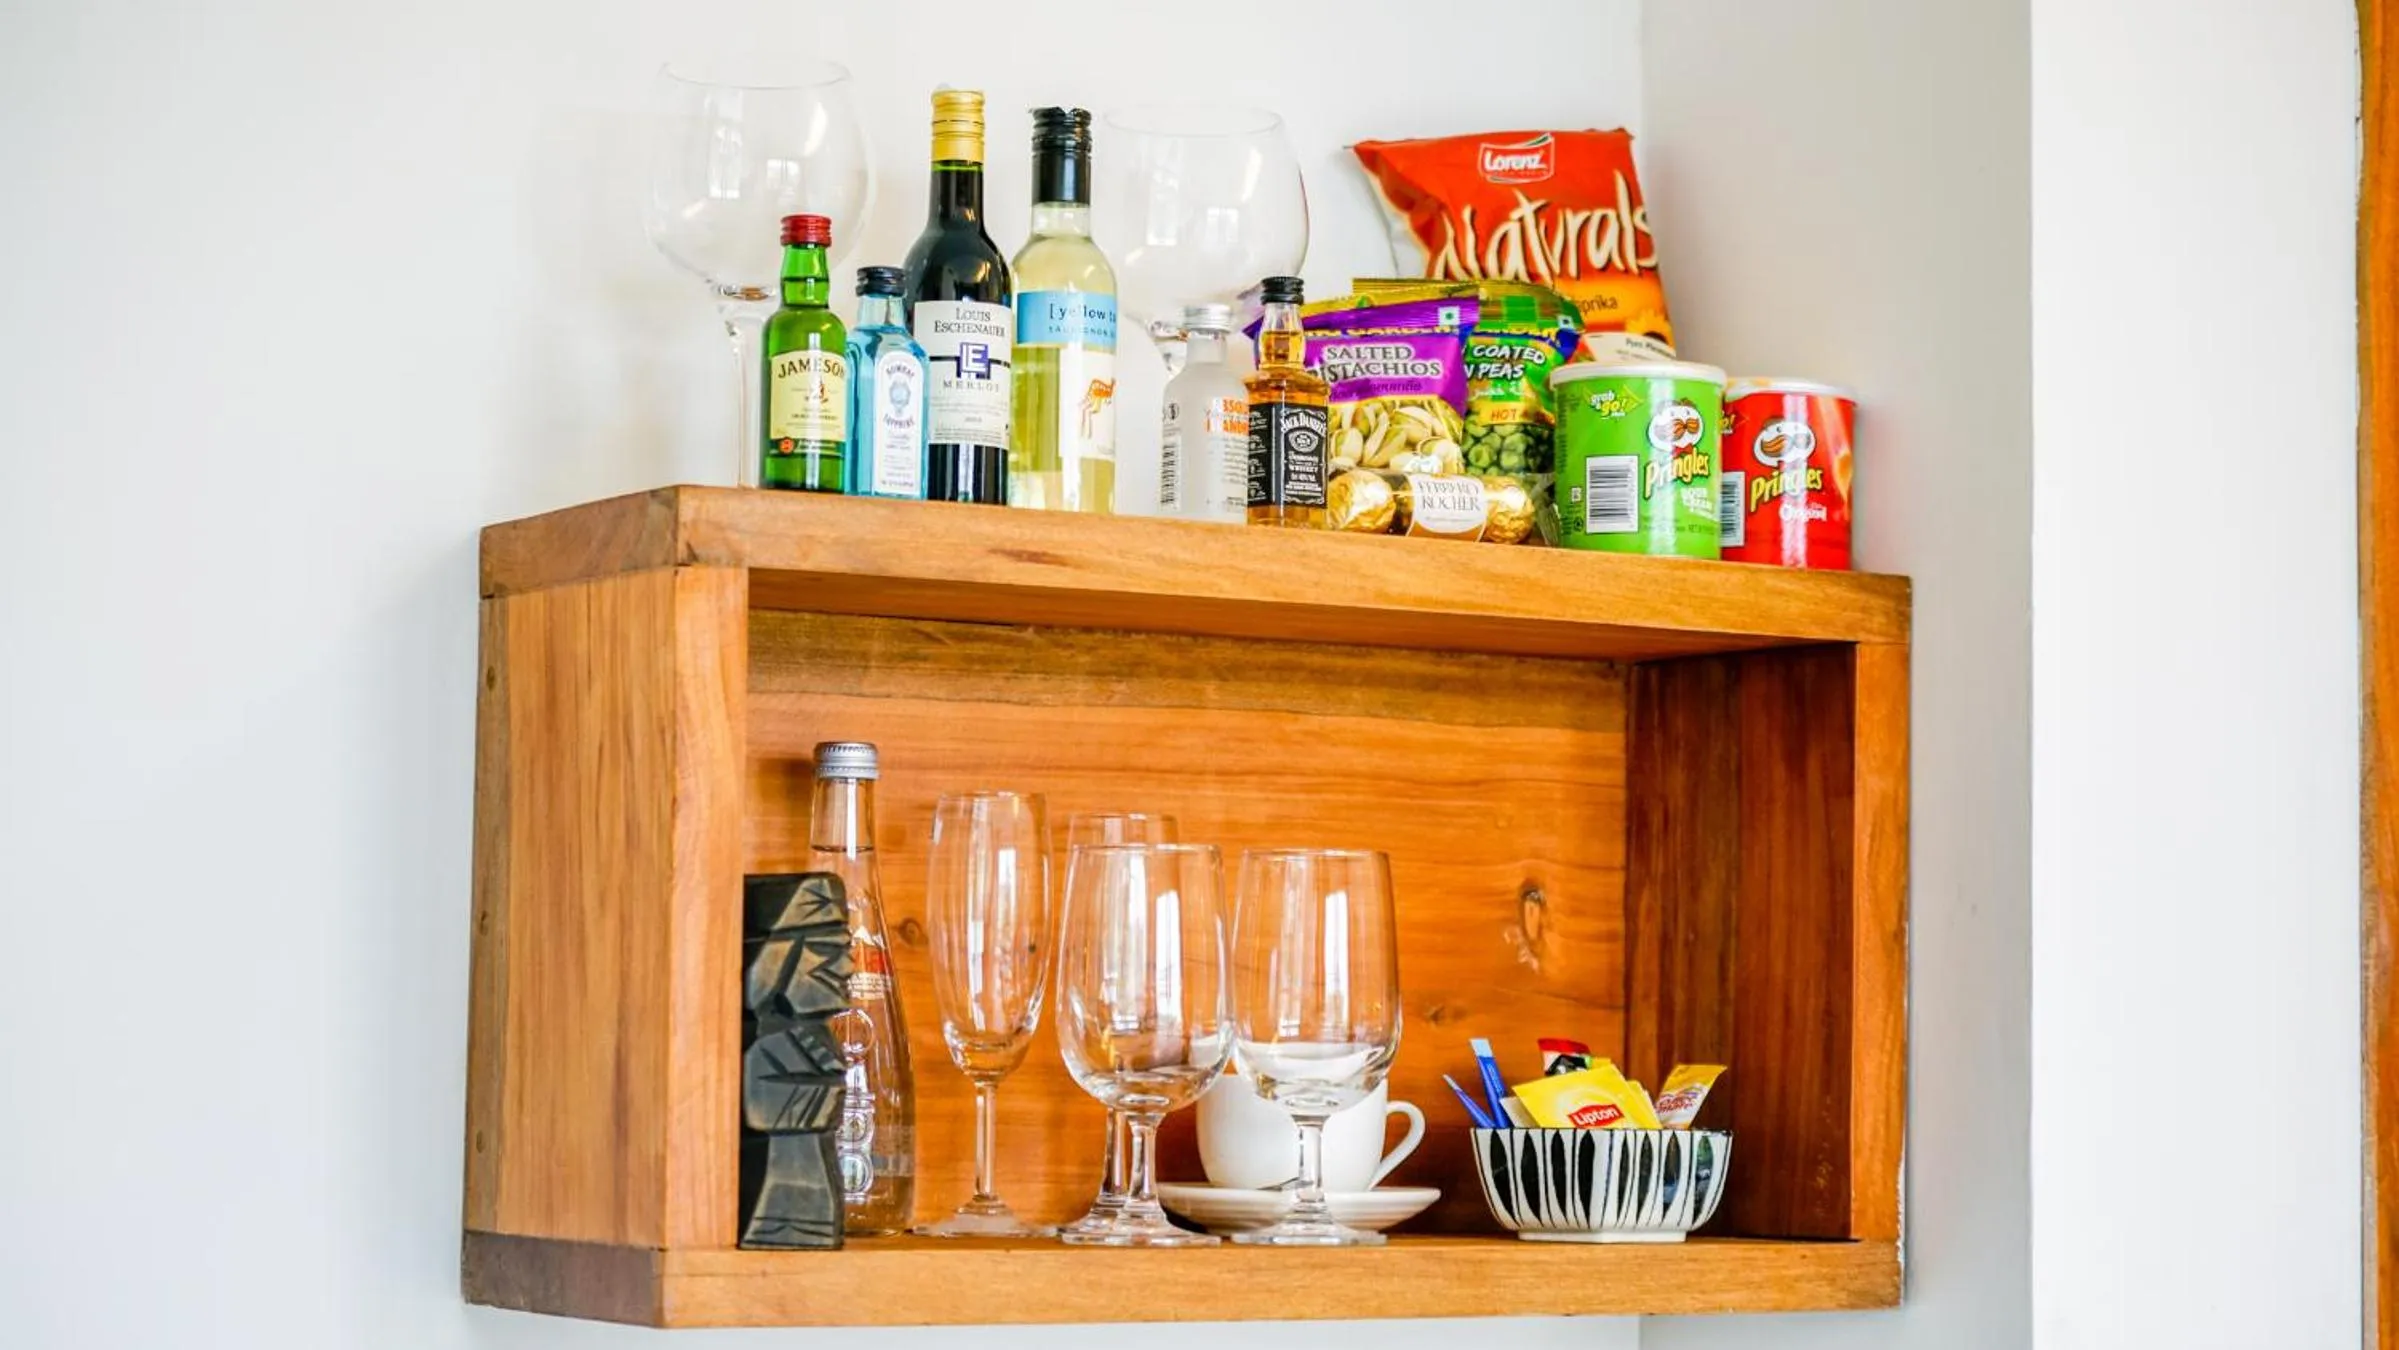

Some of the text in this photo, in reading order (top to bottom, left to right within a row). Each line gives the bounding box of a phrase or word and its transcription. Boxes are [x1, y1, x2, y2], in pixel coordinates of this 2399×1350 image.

[1484, 149, 1547, 172] Lorenz
[1431, 168, 1656, 290] Naturals
[955, 307, 992, 322] LOUIS
[1326, 346, 1412, 361] SALTED
[1472, 344, 1546, 364] COATED
[1478, 363, 1524, 380] PEAS
[1491, 408, 1517, 421] HOT
[1643, 447, 1710, 500] Pringles
[1750, 467, 1824, 513] Pringles
[1422, 495, 1480, 512] ROCHER
[1571, 1106, 1620, 1127] Lipton
